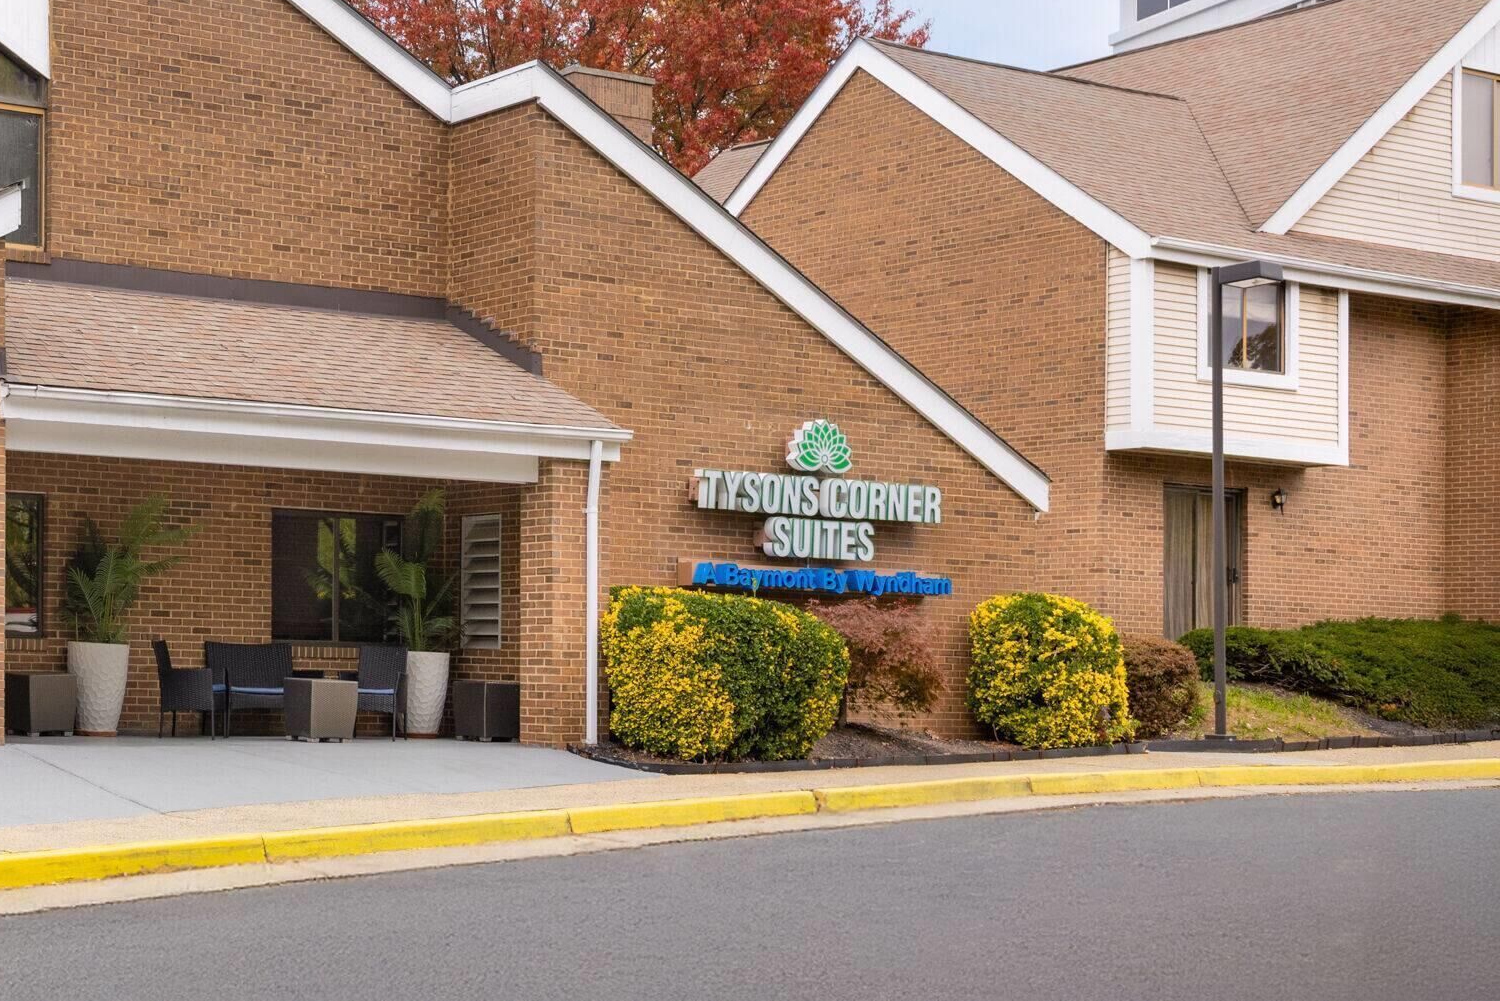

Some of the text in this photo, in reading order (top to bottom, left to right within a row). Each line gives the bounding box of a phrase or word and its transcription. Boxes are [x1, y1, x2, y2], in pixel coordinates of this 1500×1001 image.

[700, 469, 942, 524] TYSONS CORNER
[769, 517, 875, 562] SUITES
[700, 562, 952, 596] A Baymont By Wyndham
